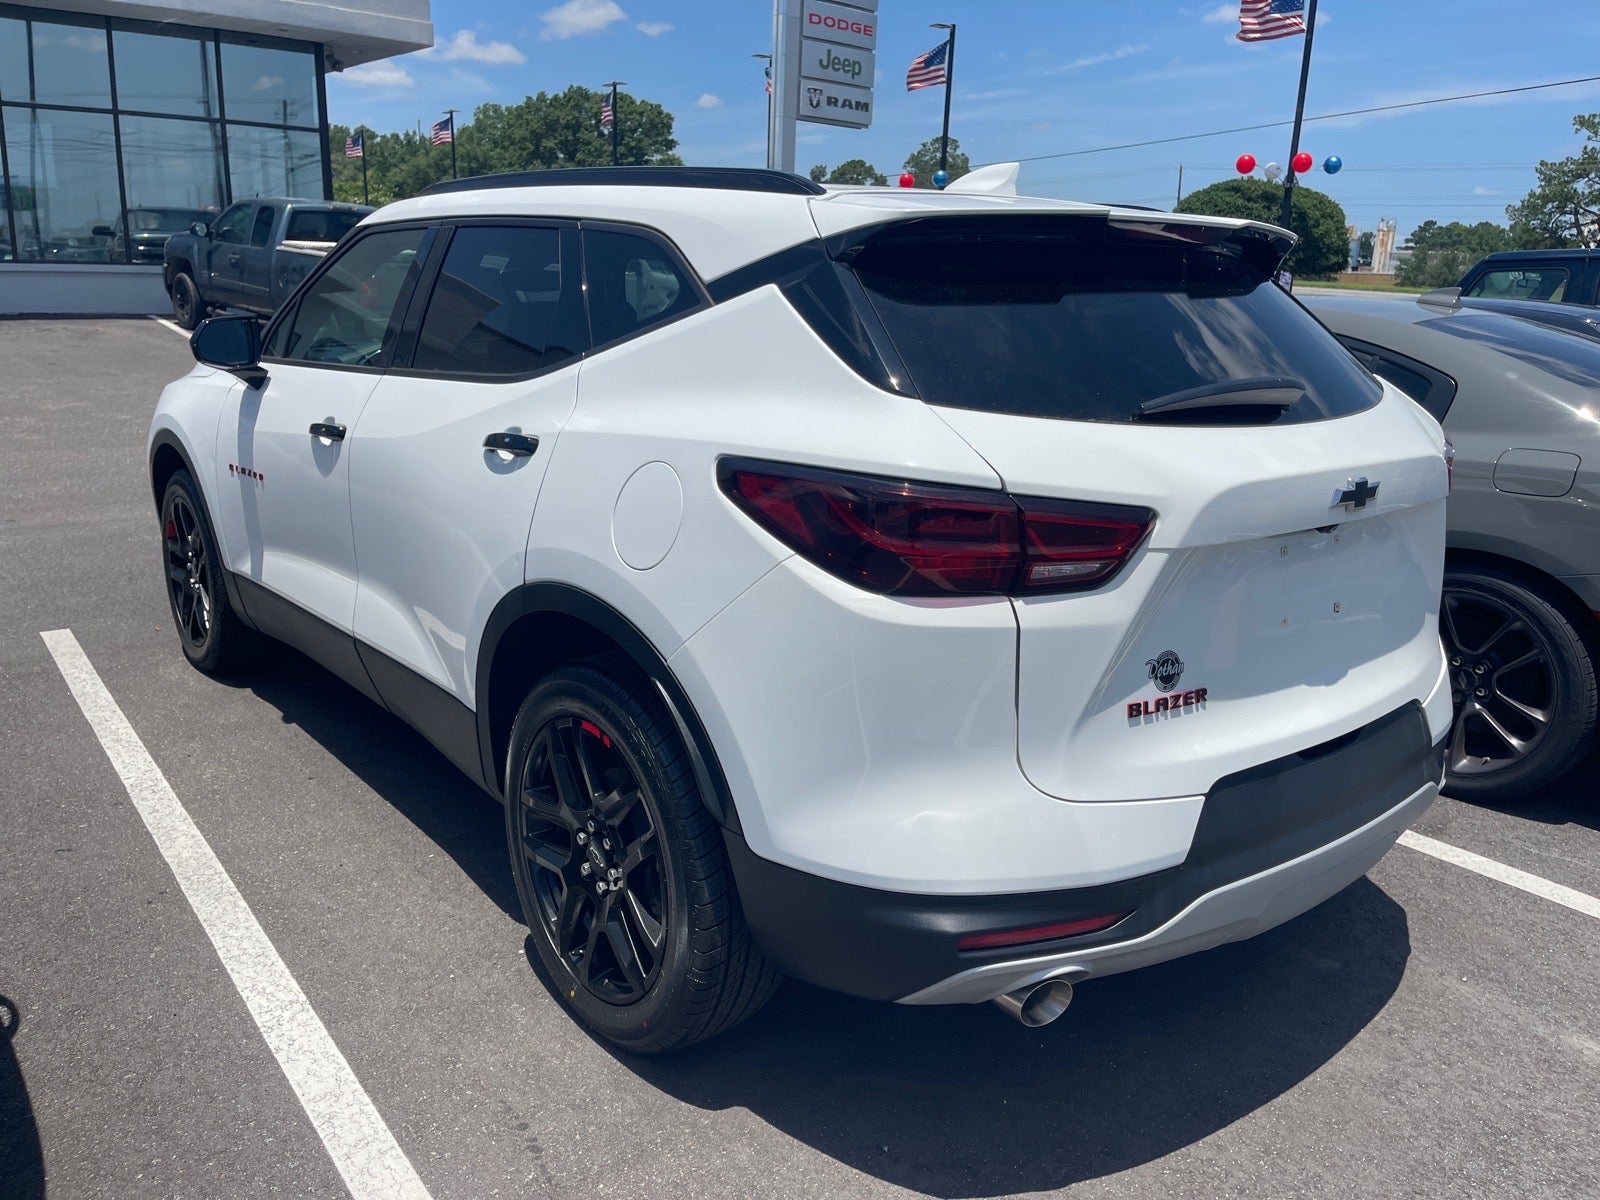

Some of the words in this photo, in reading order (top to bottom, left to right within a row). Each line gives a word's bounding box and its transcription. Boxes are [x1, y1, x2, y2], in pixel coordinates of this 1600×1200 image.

[808, 12, 874, 37] DODGE
[818, 48, 862, 80] Jeep
[826, 95, 870, 113] RAM
[228, 463, 264, 481] BLAZER
[1145, 658, 1184, 680] Dothan
[1127, 687, 1208, 719] BLAZER
